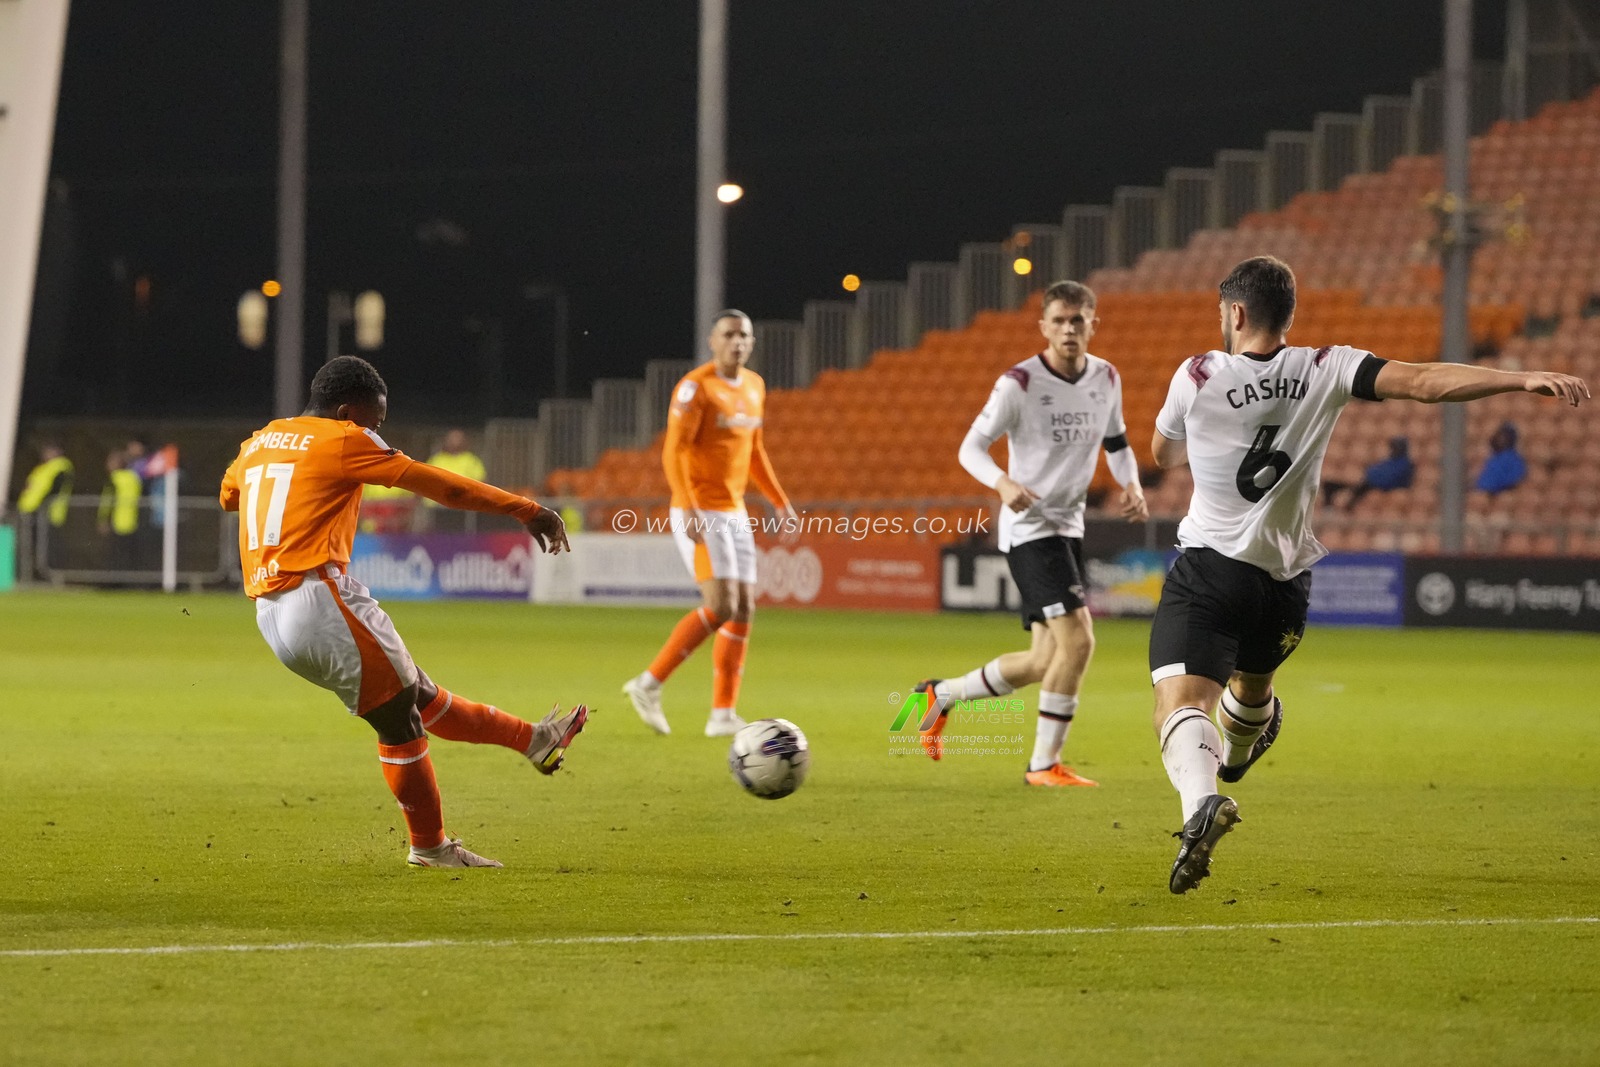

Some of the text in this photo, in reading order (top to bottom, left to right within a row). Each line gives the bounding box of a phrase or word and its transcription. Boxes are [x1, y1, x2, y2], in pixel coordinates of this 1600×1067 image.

[1226, 378, 1310, 409] CASHIN
[1051, 412, 1089, 426] HOST
[1052, 429, 1091, 442] STAY
[1236, 425, 1293, 503] 6
